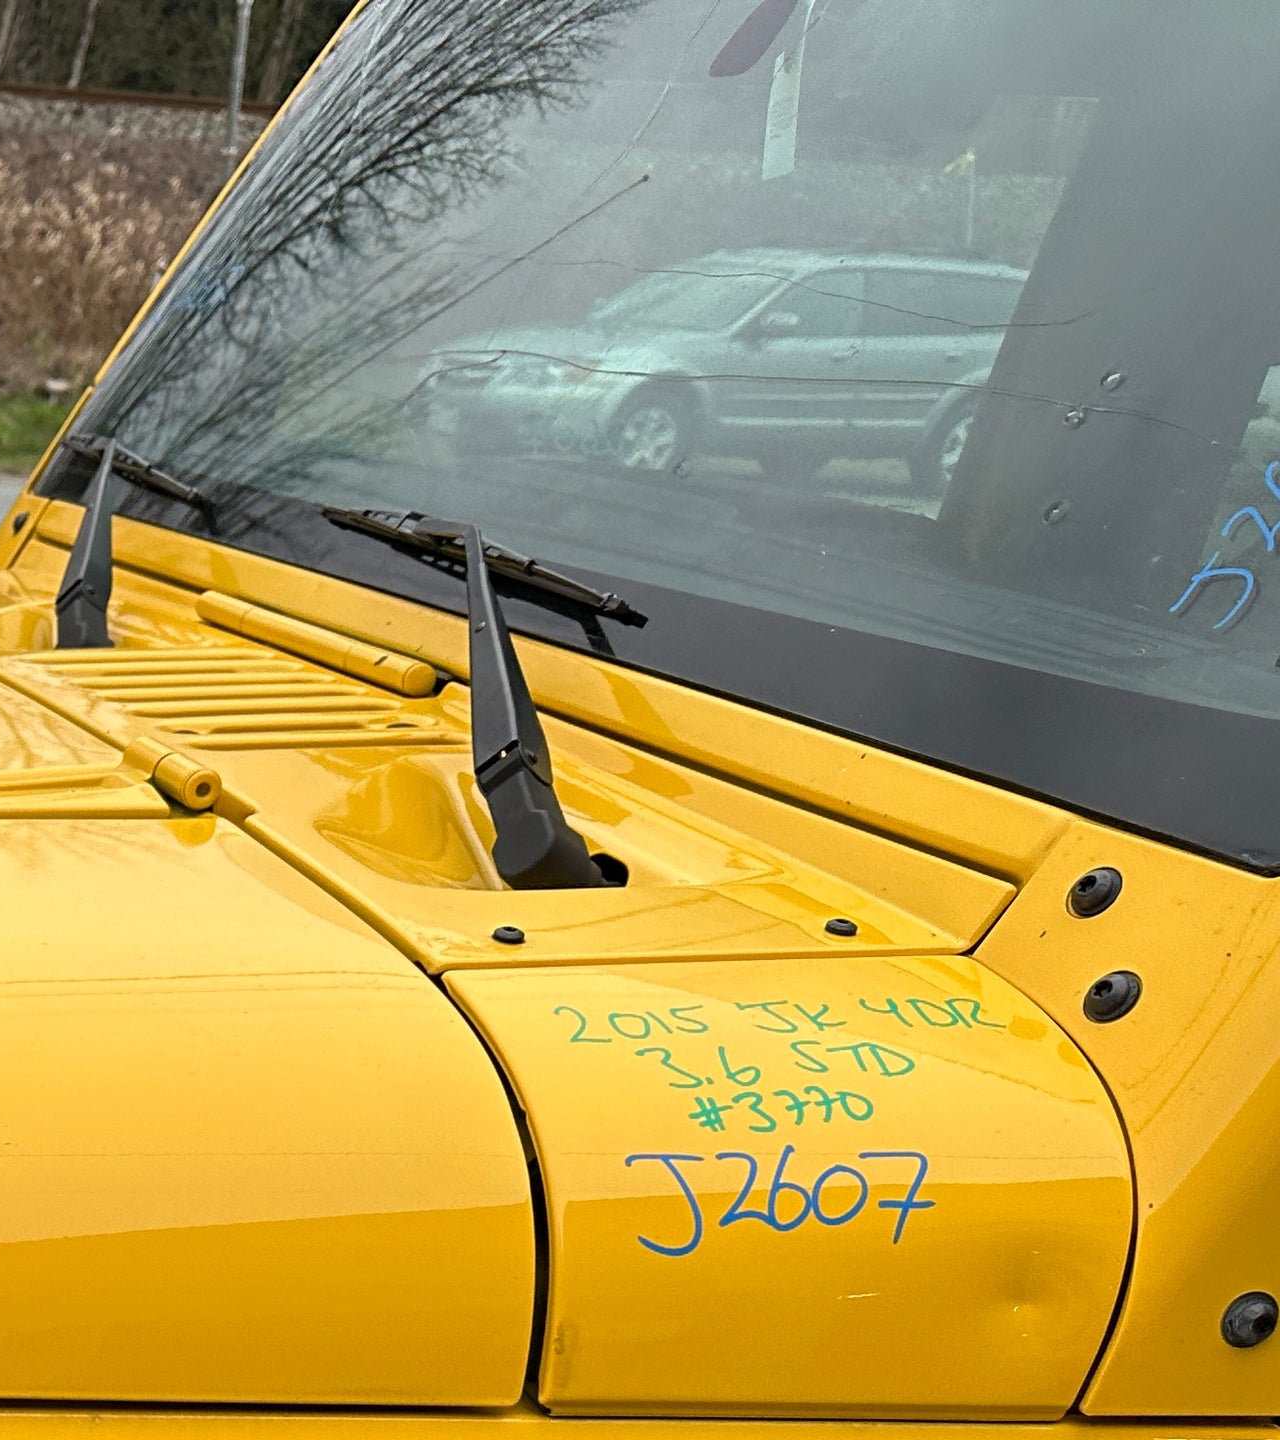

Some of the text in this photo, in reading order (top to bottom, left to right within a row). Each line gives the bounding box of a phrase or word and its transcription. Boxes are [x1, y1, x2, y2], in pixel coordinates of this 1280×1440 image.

[554, 997, 1007, 1044] 2015 JK 4DR
[634, 1039, 916, 1090] 3.6 STD
[688, 1085, 875, 1133] #3770
[624, 1144, 937, 1257] J2607
